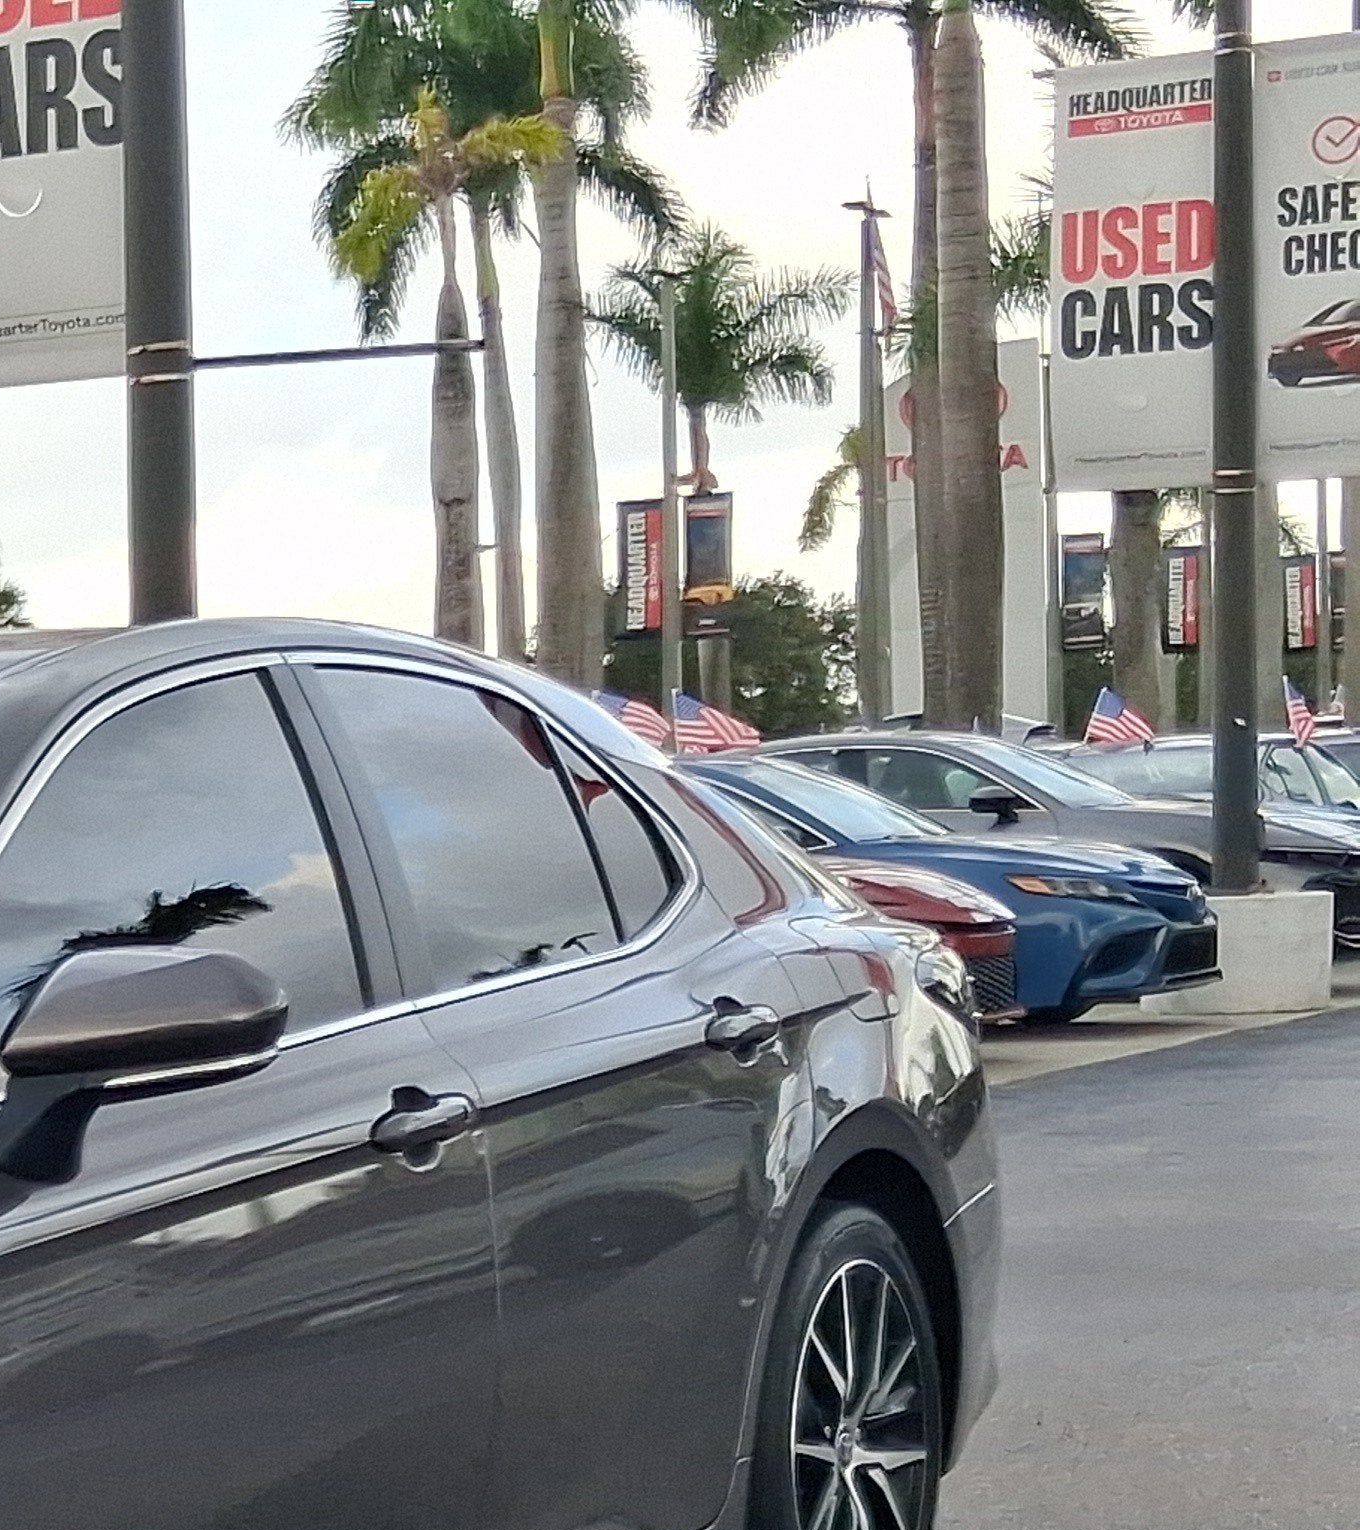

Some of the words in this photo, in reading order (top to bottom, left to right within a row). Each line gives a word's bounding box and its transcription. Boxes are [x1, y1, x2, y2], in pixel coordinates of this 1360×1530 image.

[1068, 78, 1212, 117] HEADQUARTER
[1117, 110, 1184, 129] TOYOTA
[1062, 200, 1215, 283] USED
[1062, 278, 1214, 360] CARS
[626, 511, 649, 630] HEADQUARTER
